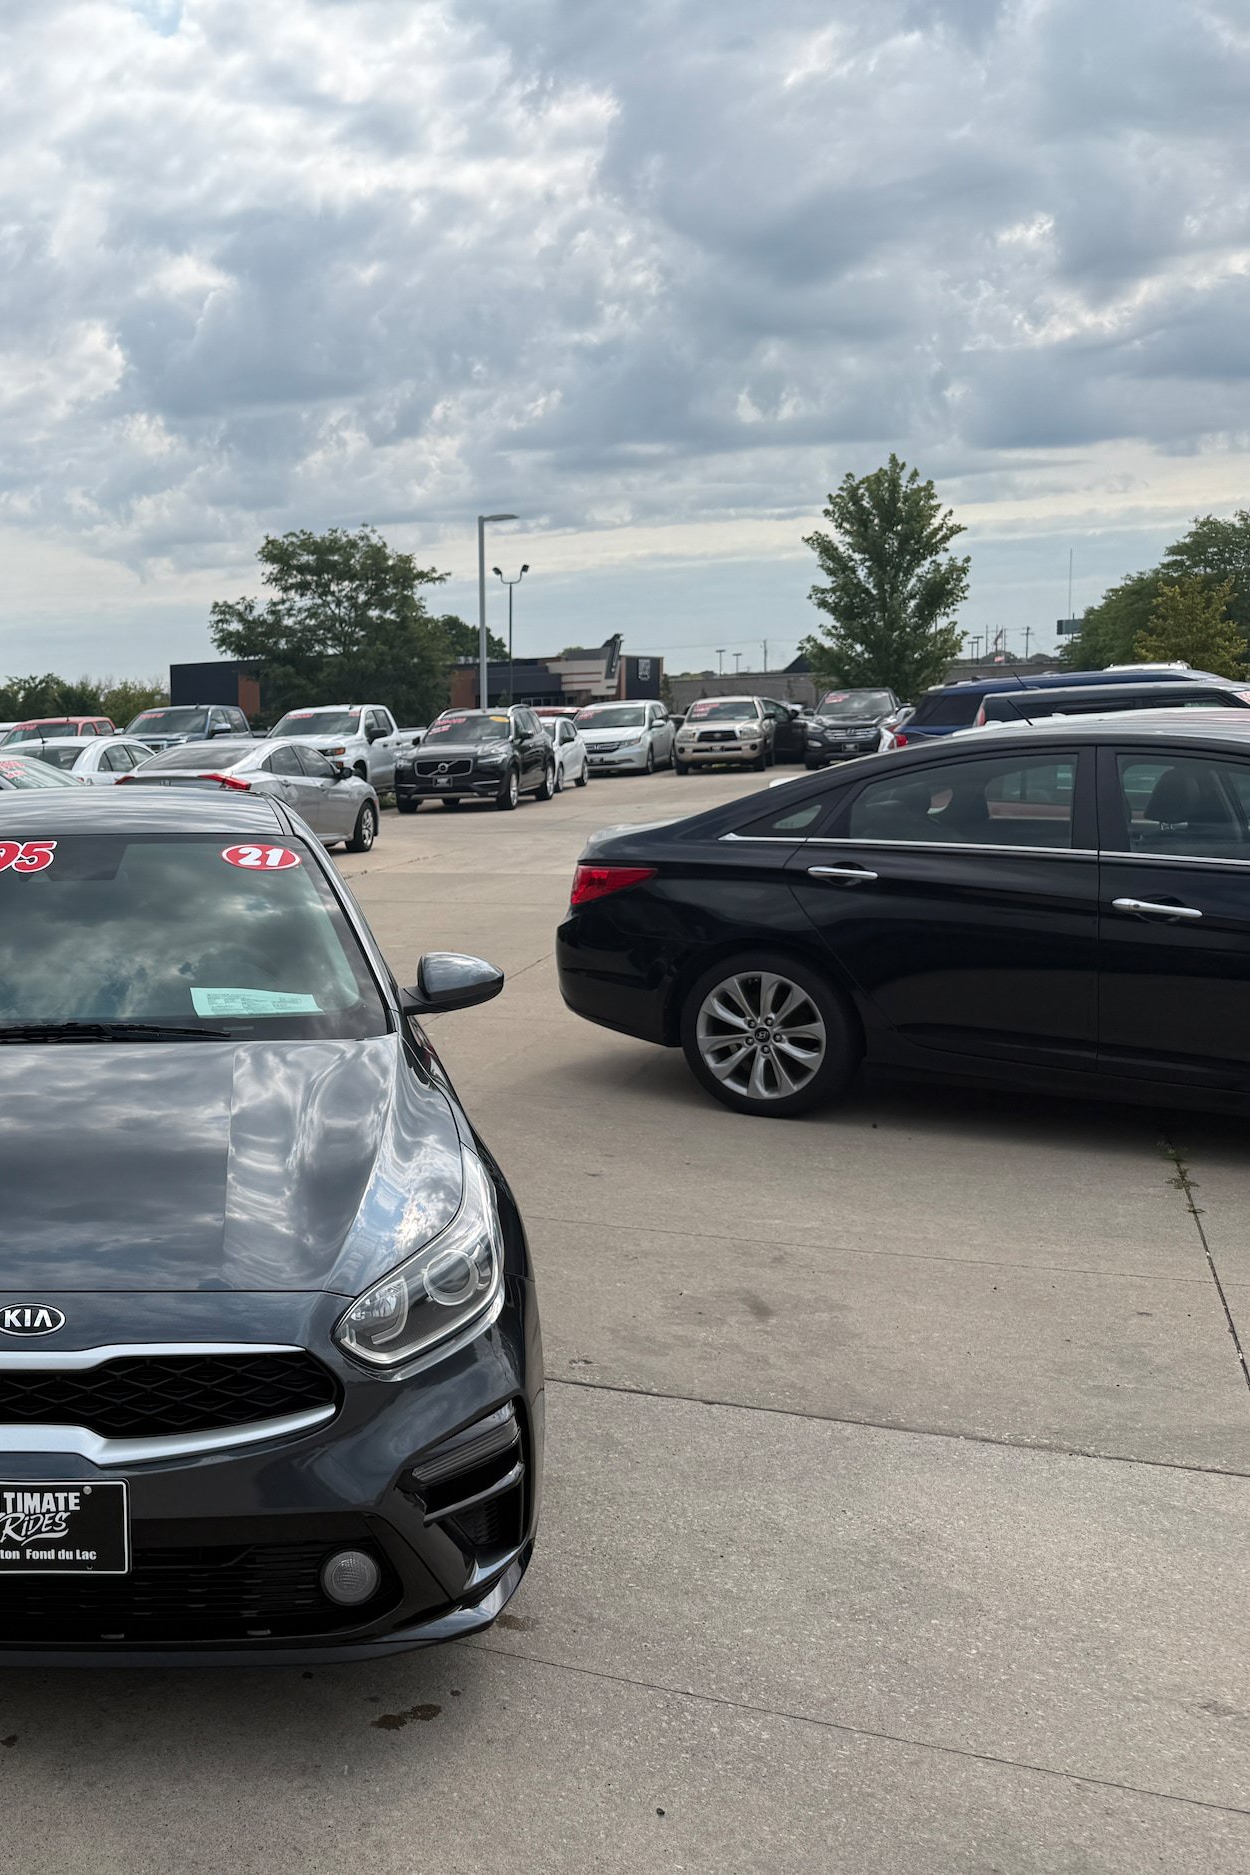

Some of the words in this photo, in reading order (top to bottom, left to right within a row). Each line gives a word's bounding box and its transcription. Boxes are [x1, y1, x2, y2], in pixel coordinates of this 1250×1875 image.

[238, 847, 284, 866] 21
[4, 1308, 53, 1328] KIA
[25, 1549, 55, 1560] Fond
[58, 1549, 74, 1560] du
[76, 1549, 97, 1560] Lac
